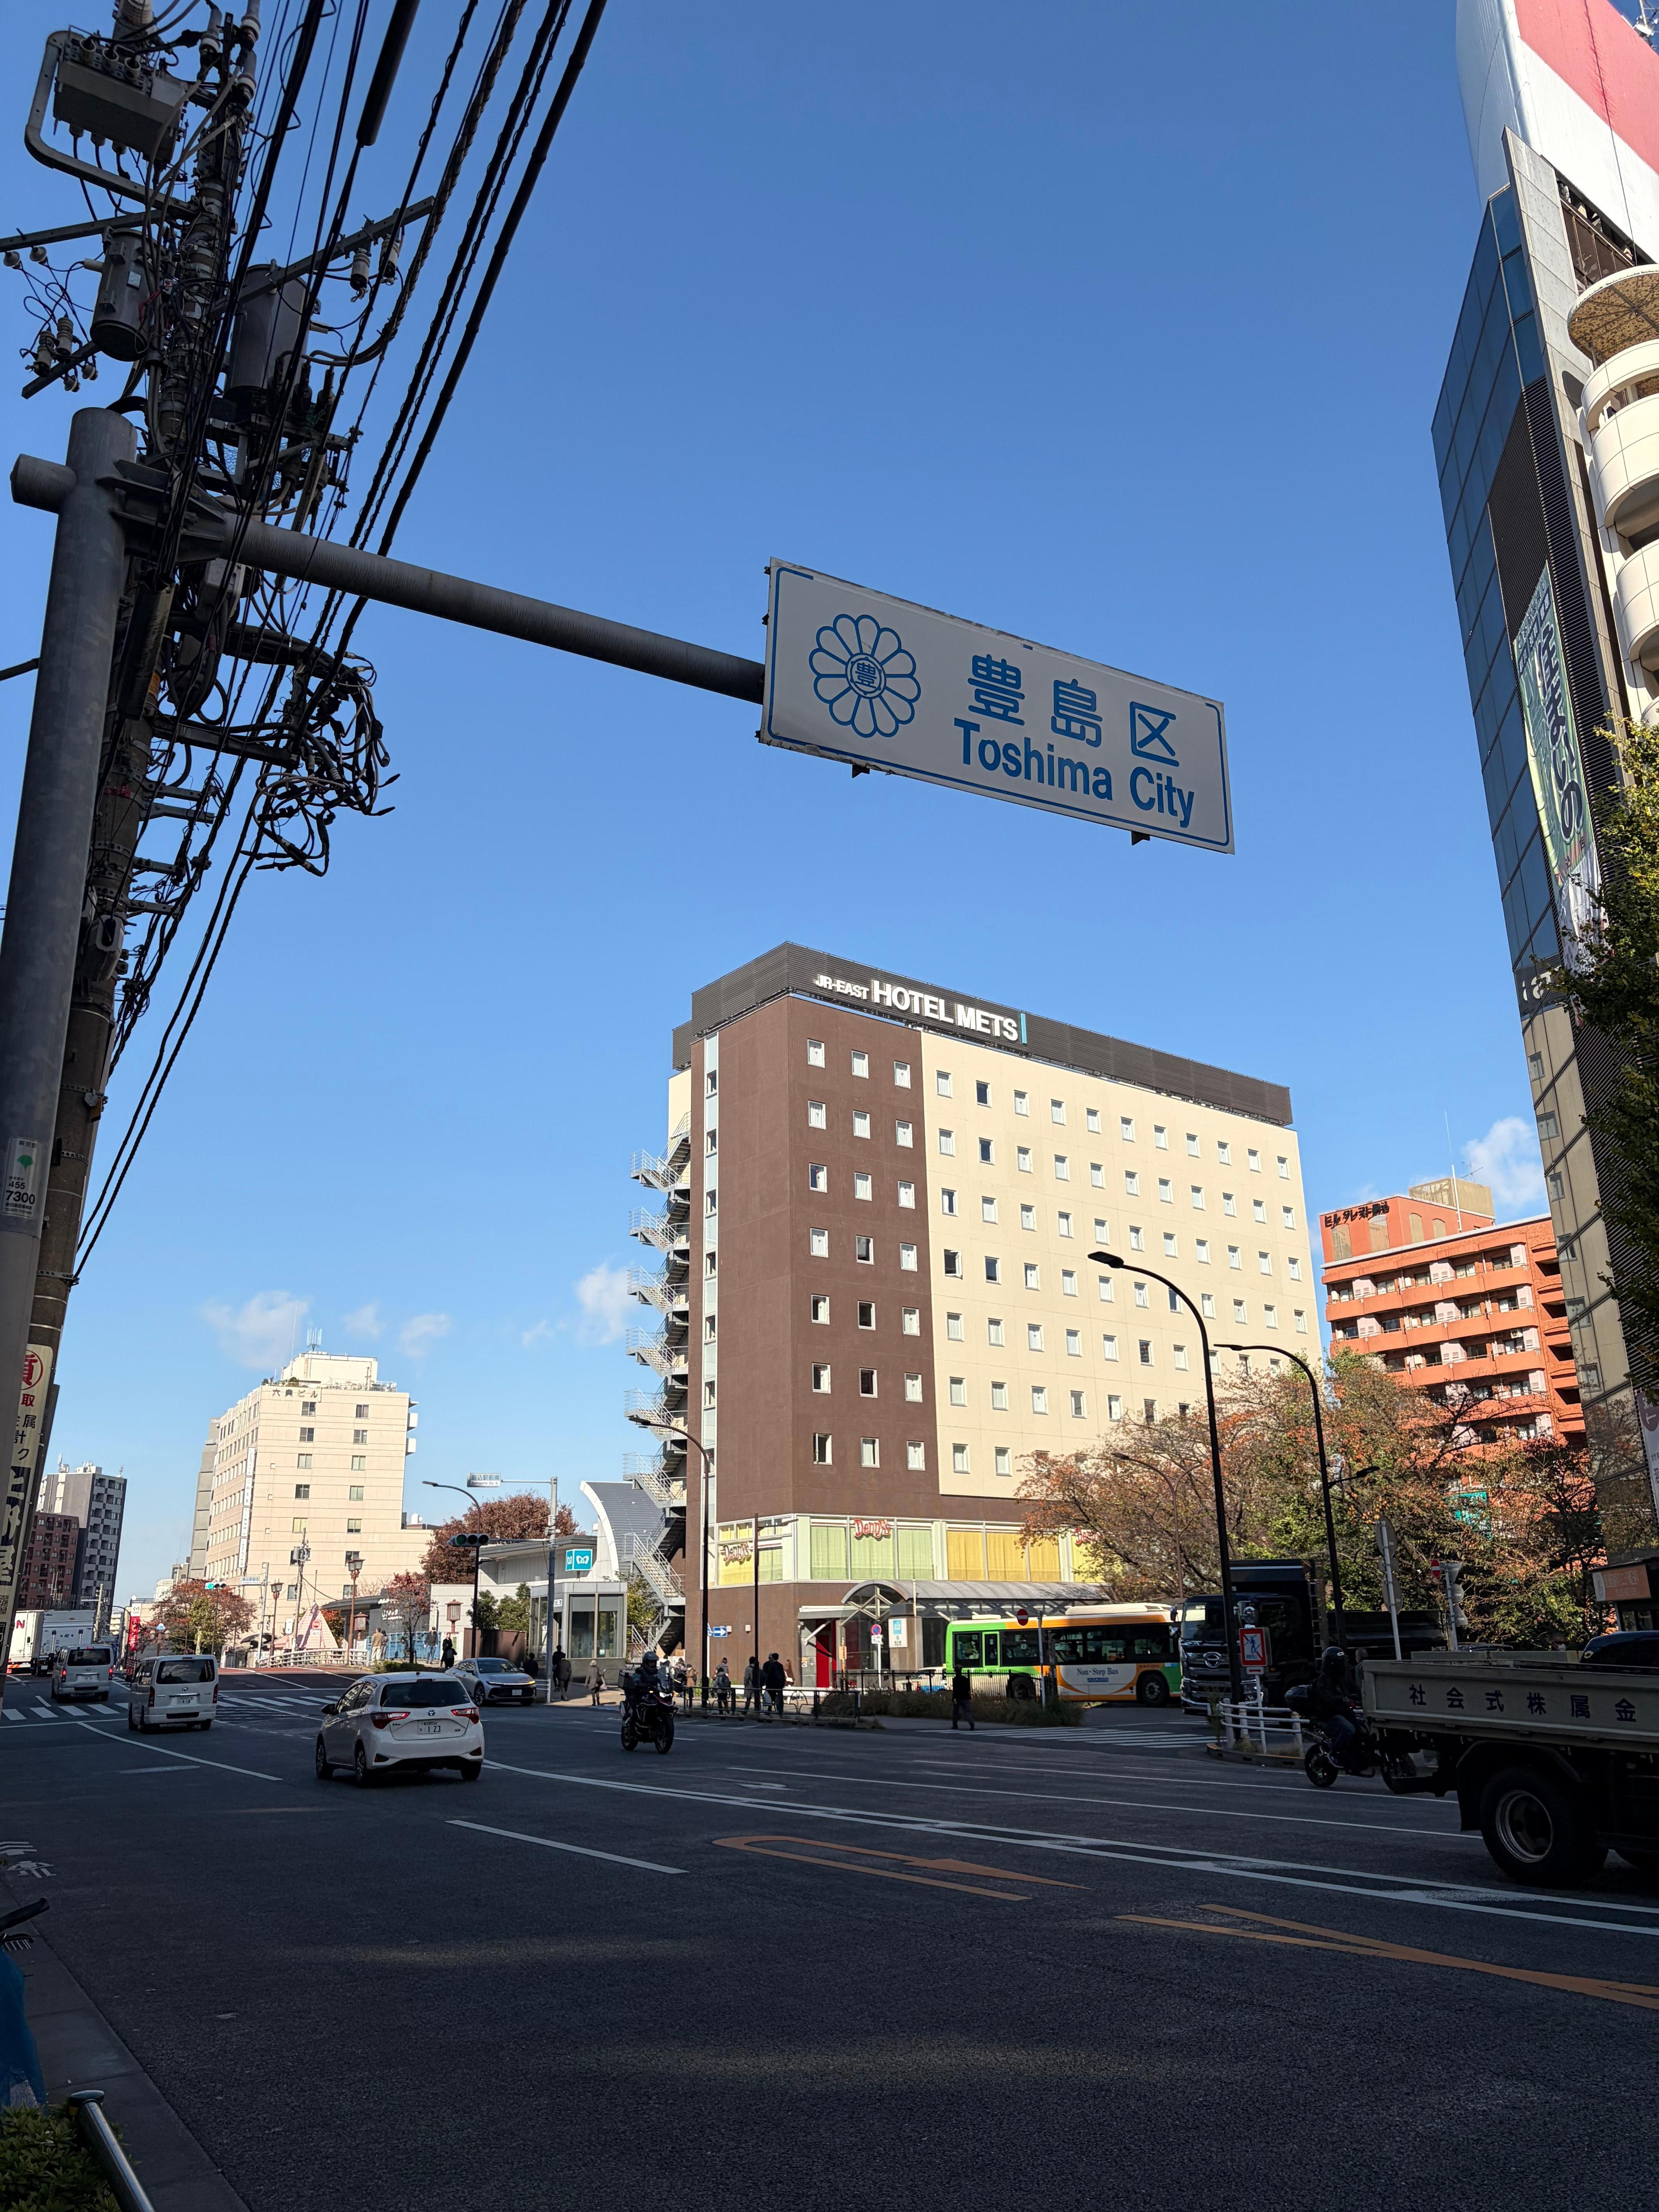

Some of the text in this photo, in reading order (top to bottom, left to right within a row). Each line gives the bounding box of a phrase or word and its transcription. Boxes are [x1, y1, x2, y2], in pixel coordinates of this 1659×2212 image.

[967, 654, 1180, 768] 豊島区
[954, 718, 1195, 828] Toshima City
[815, 975, 1018, 1042] JR-EAST HOTEL METS
[9, 1181, 25, 1189] 455
[6, 1190, 35, 1204] 7300
[853, 1518, 891, 1539] Denny's
[723, 1541, 752, 1562] Denny's
